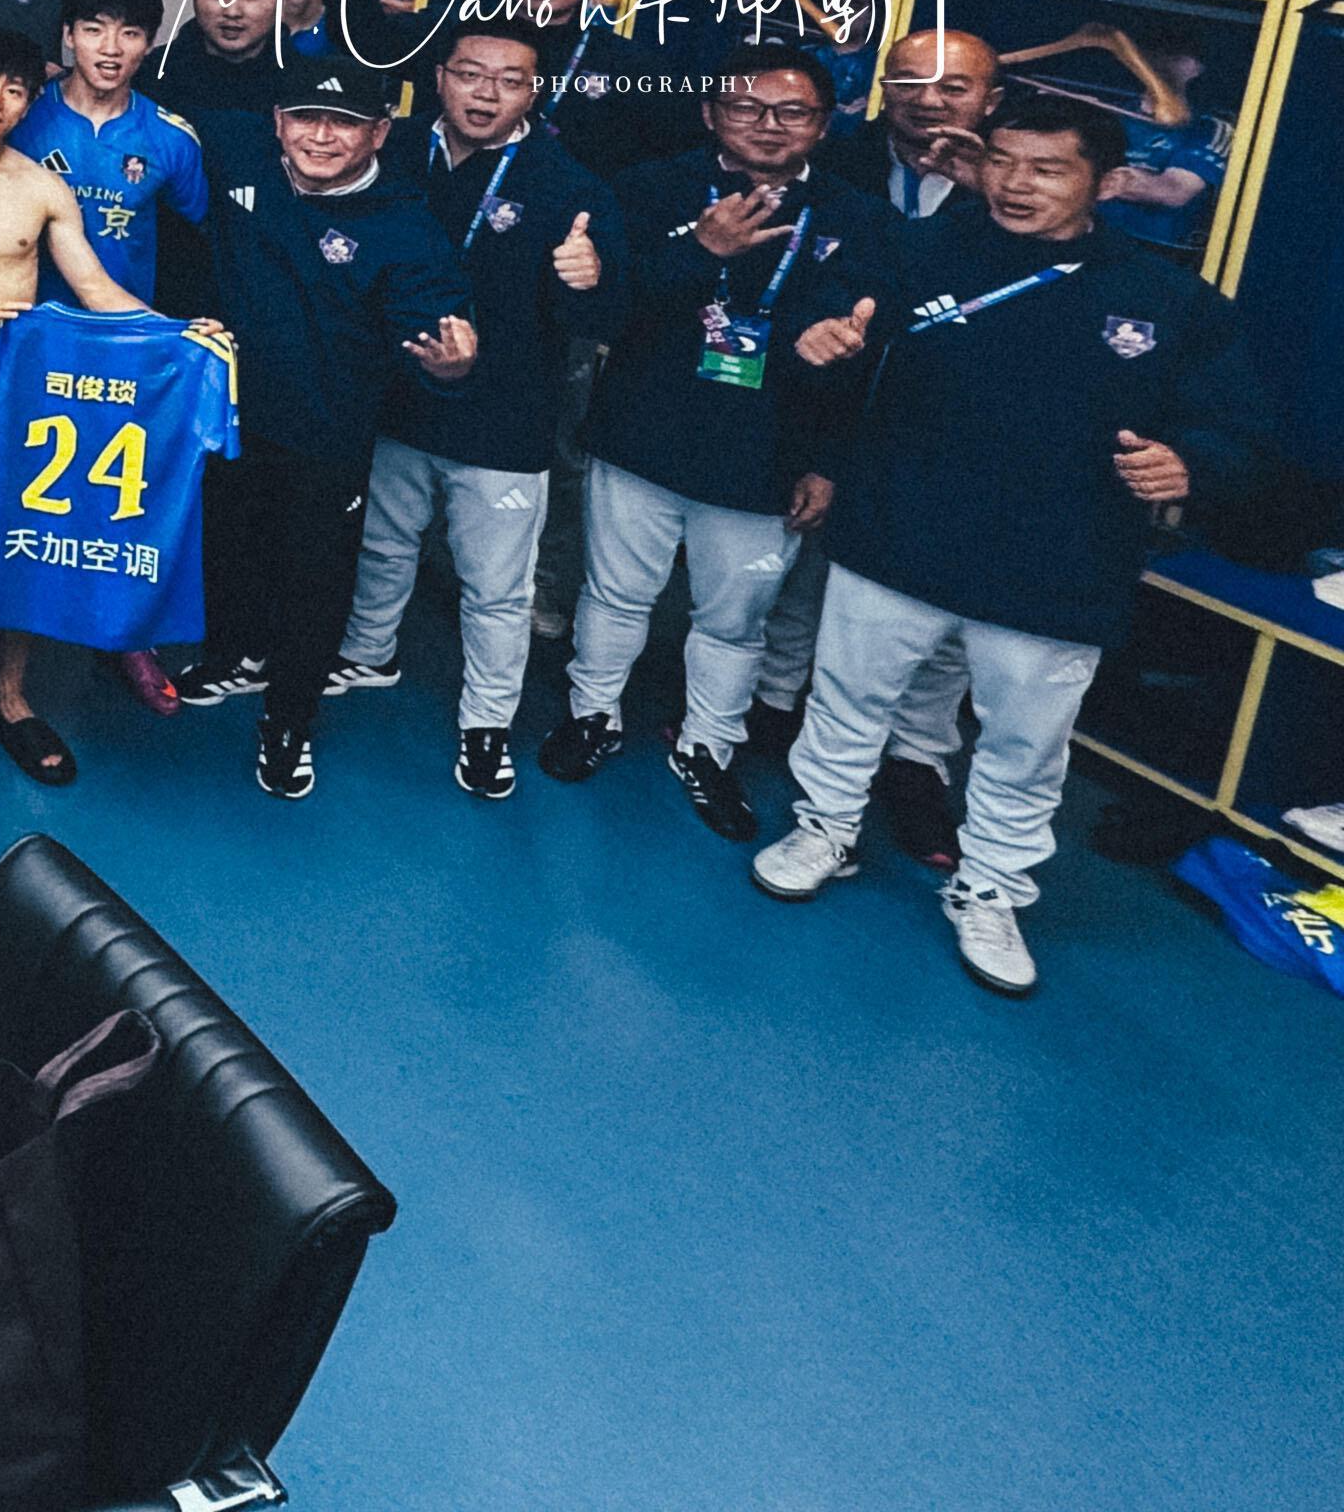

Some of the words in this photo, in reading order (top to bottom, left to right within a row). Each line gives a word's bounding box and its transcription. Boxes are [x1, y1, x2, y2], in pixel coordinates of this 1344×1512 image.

[97, 204, 136, 240] 京
[46, 372, 138, 406] 司俊琰
[21, 414, 149, 521] 24
[3, 527, 160, 584] 天加空调
